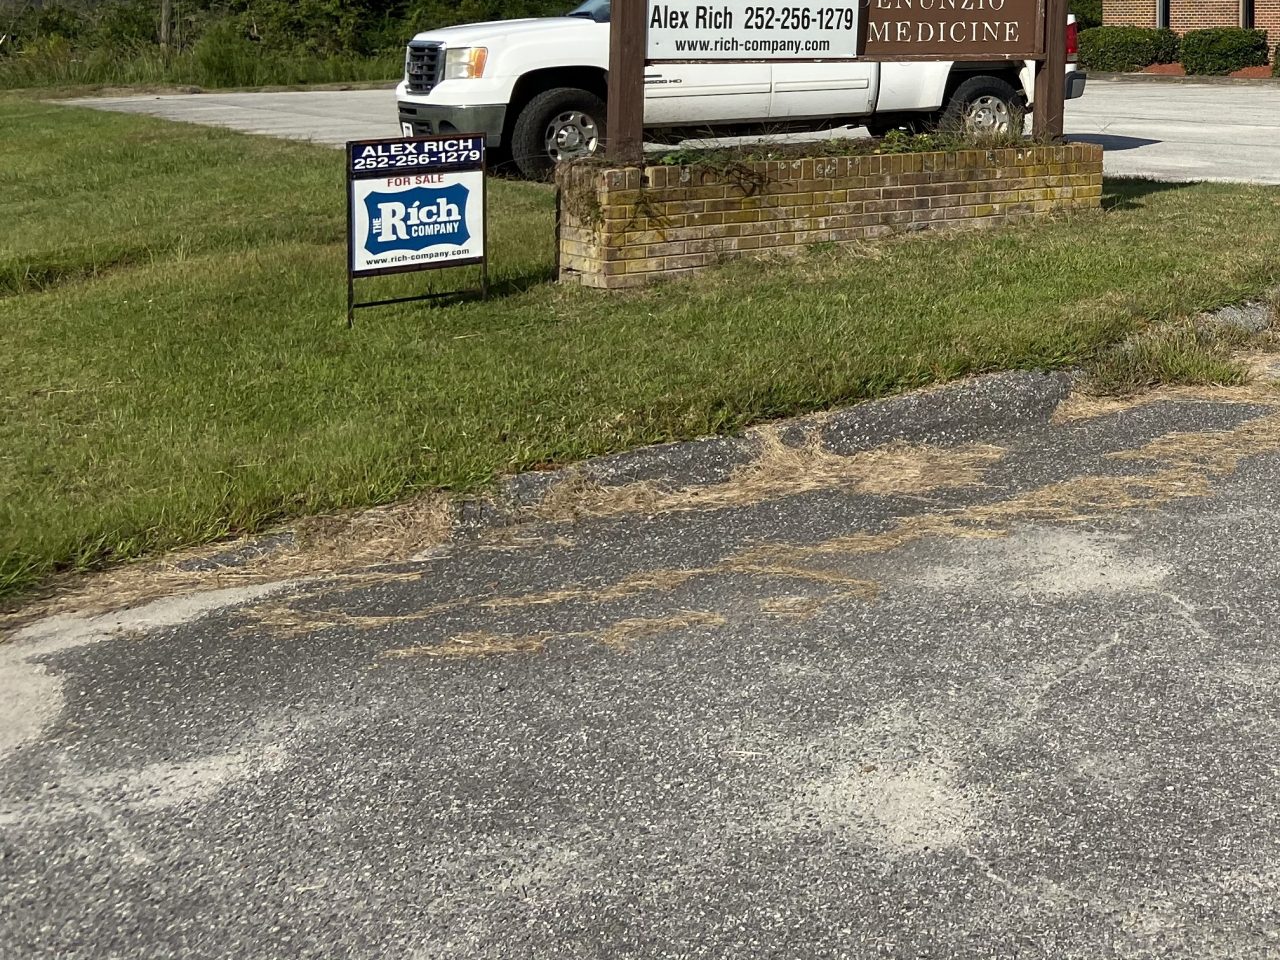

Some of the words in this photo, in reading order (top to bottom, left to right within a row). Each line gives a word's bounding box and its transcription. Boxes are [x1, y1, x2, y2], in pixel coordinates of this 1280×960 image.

[650, 5, 689, 29] Alex
[695, 5, 733, 29] Rich
[744, 6, 854, 31] 252-256-1279
[868, 20, 1020, 42] MEDICINE
[675, 37, 830, 54] www.rich-company.com
[361, 143, 417, 157] ALEX
[424, 139, 472, 153] RICH
[354, 150, 480, 169] 252-256-1279
[387, 176, 411, 187] FOR
[415, 174, 444, 185] SALE
[373, 218, 382, 233] THE
[377, 197, 461, 243] Rich
[411, 222, 459, 237] COMPANY
[366, 248, 469, 265] www.rich-company.com
